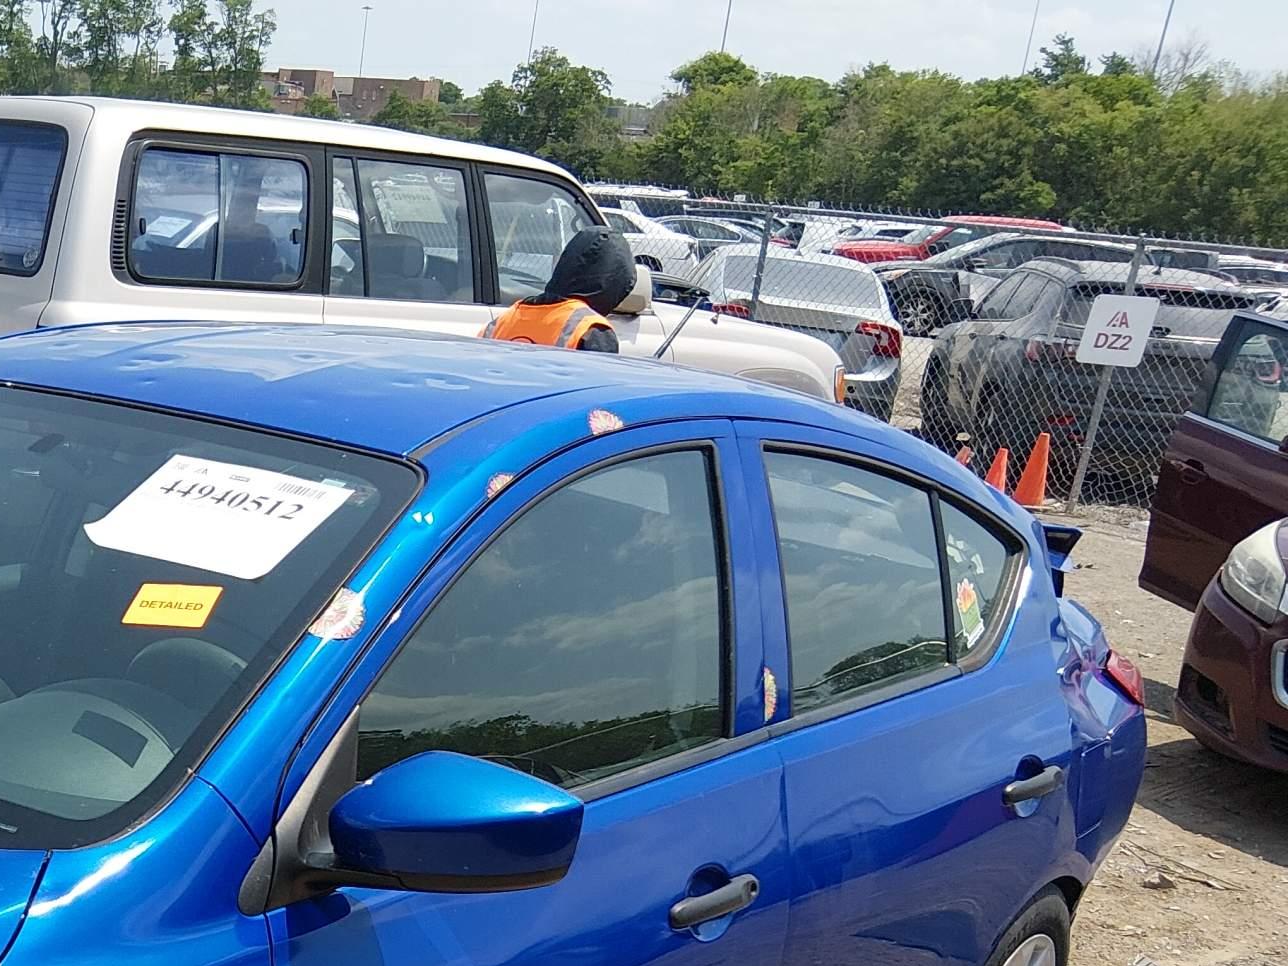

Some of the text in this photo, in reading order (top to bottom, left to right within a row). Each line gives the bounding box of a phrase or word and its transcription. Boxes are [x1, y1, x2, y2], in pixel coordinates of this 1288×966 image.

[1093, 332, 1132, 351] DZ2
[160, 480, 304, 519] 44940512
[139, 600, 204, 611] DETAILED
